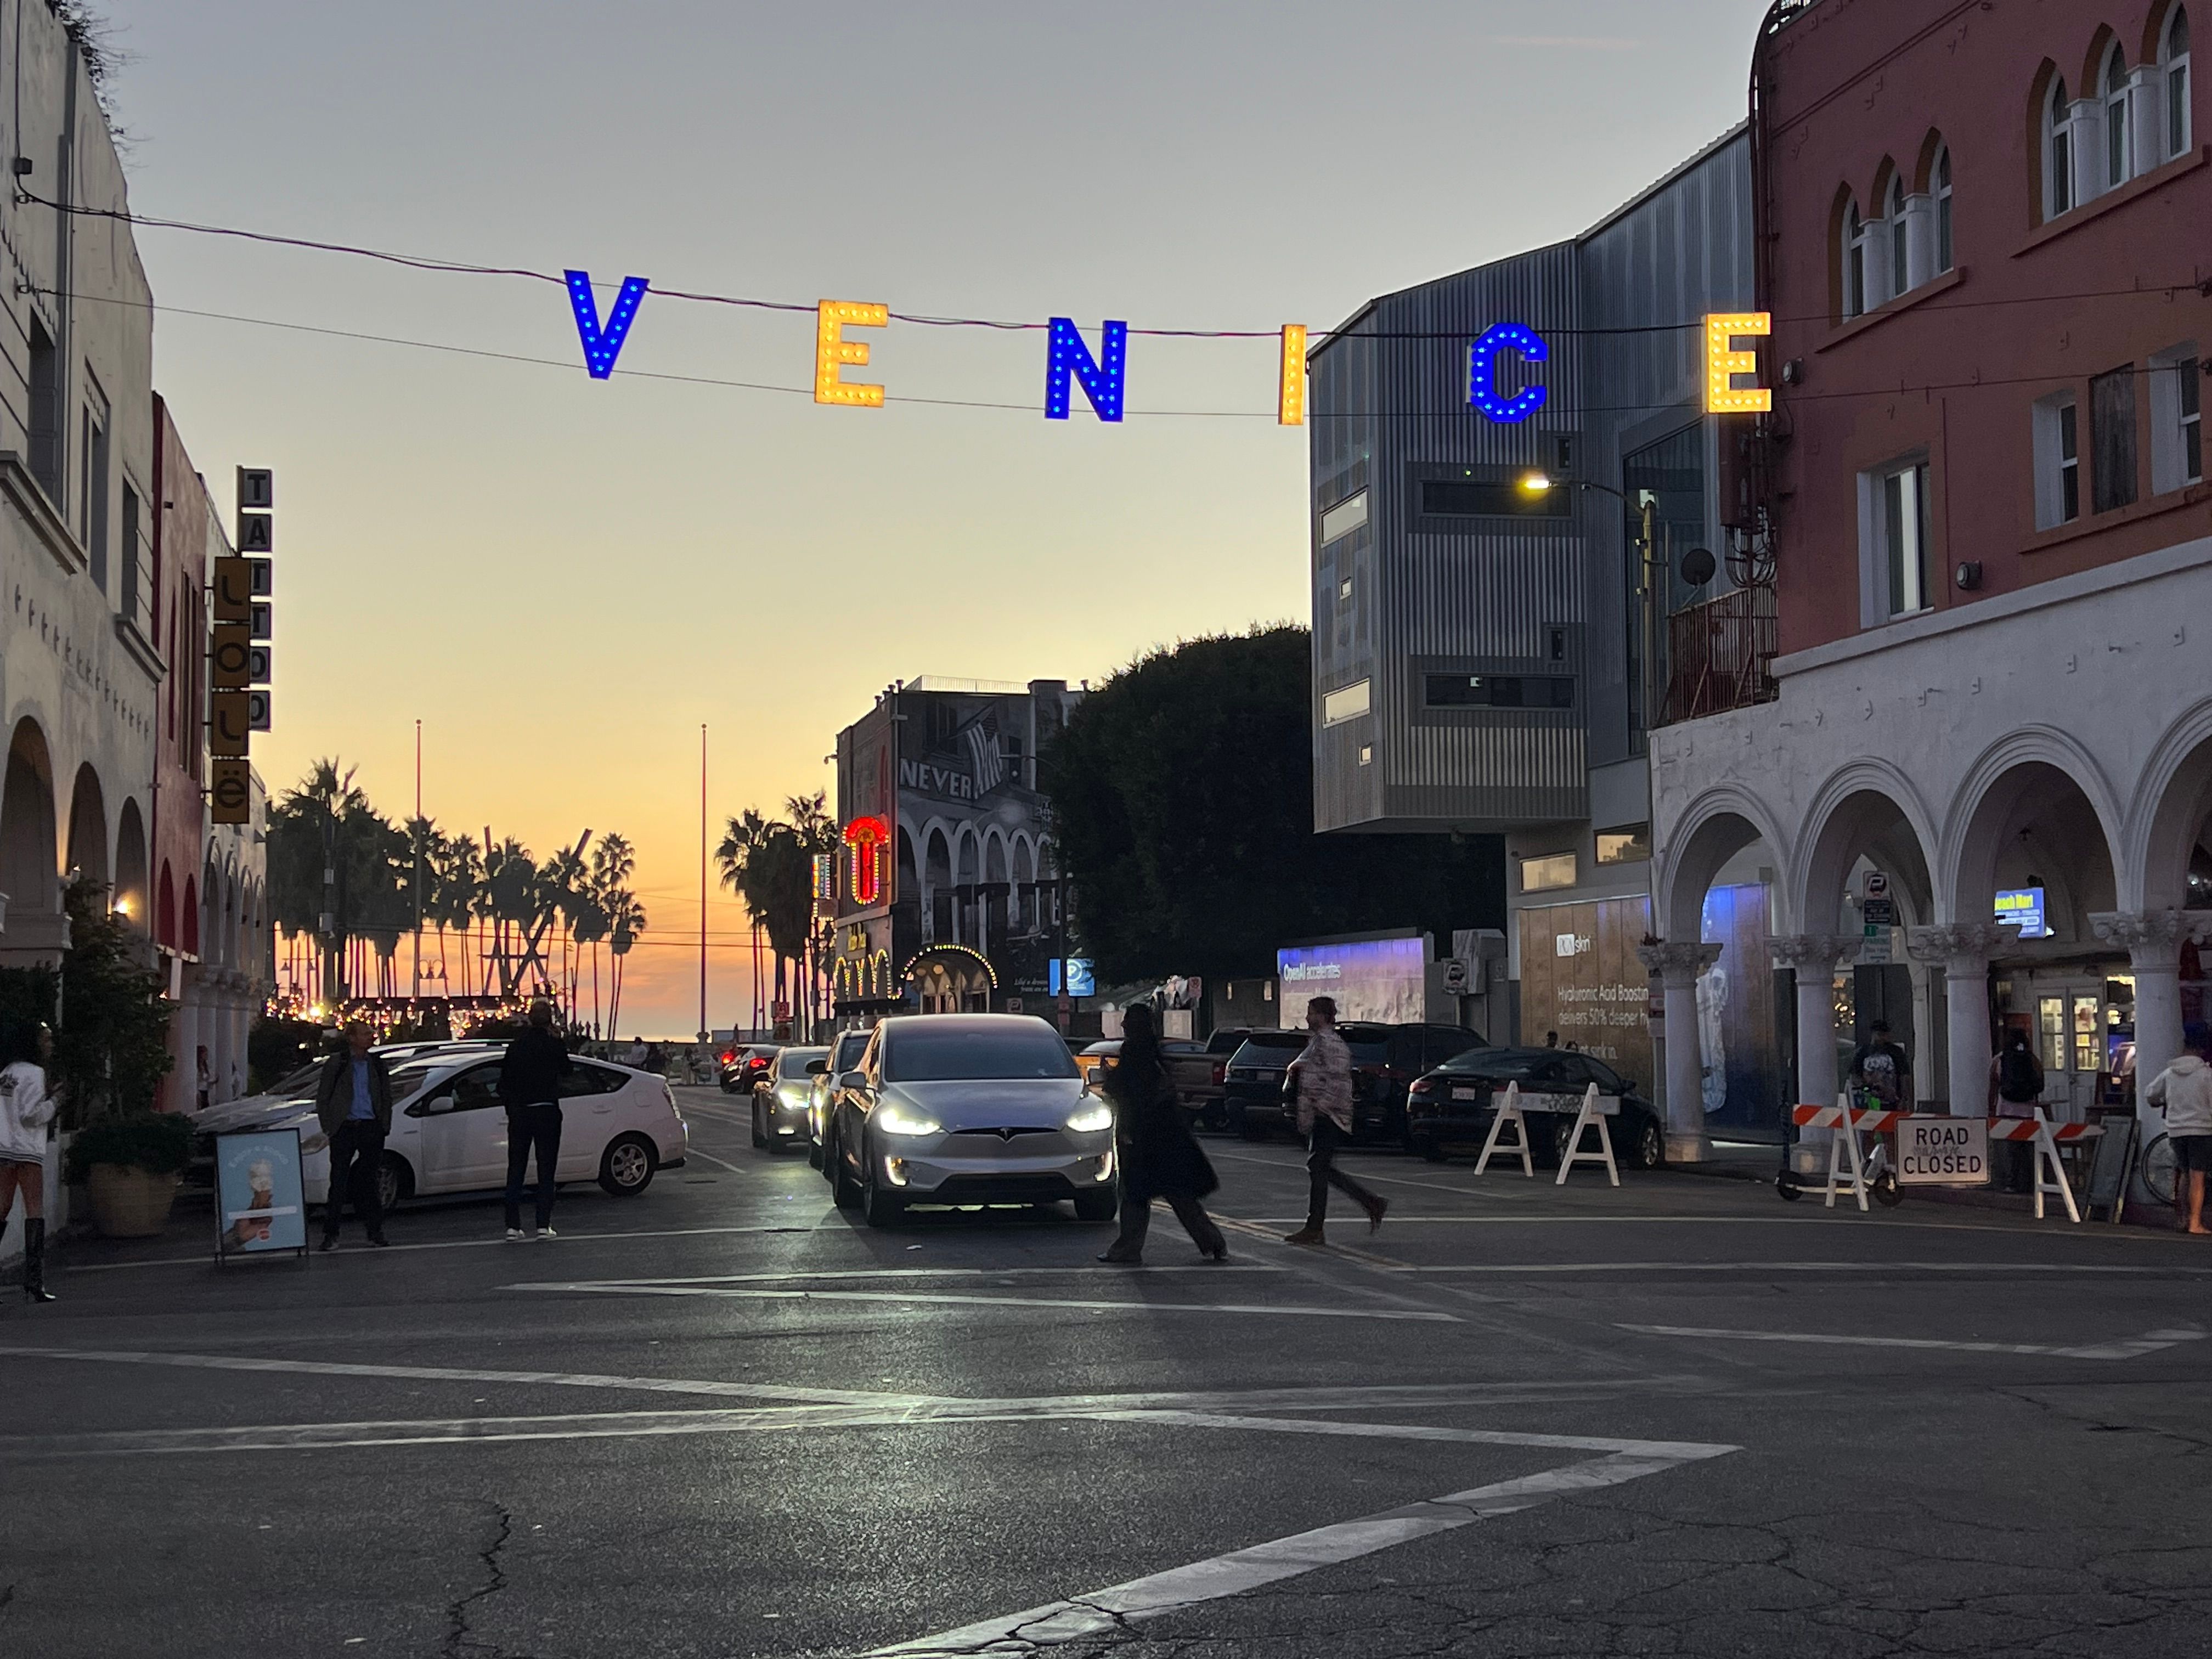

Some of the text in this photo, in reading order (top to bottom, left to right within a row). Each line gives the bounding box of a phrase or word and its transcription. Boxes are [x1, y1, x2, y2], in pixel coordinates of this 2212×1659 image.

[563, 269, 1771, 425] VENICE
[247, 474, 267, 721] TATTOO
[900, 758, 971, 799] NEVER
[1284, 961, 1341, 984] OpenAI accelerates
[1558, 983, 1649, 1005] Hyaluronic Acid Boostin
[1589, 1008, 1607, 1026] 50%
[1609, 1007, 1638, 1029] deeper
[1916, 1127, 1968, 1146] ROAD
[1904, 1155, 1981, 1174] CLOSED
